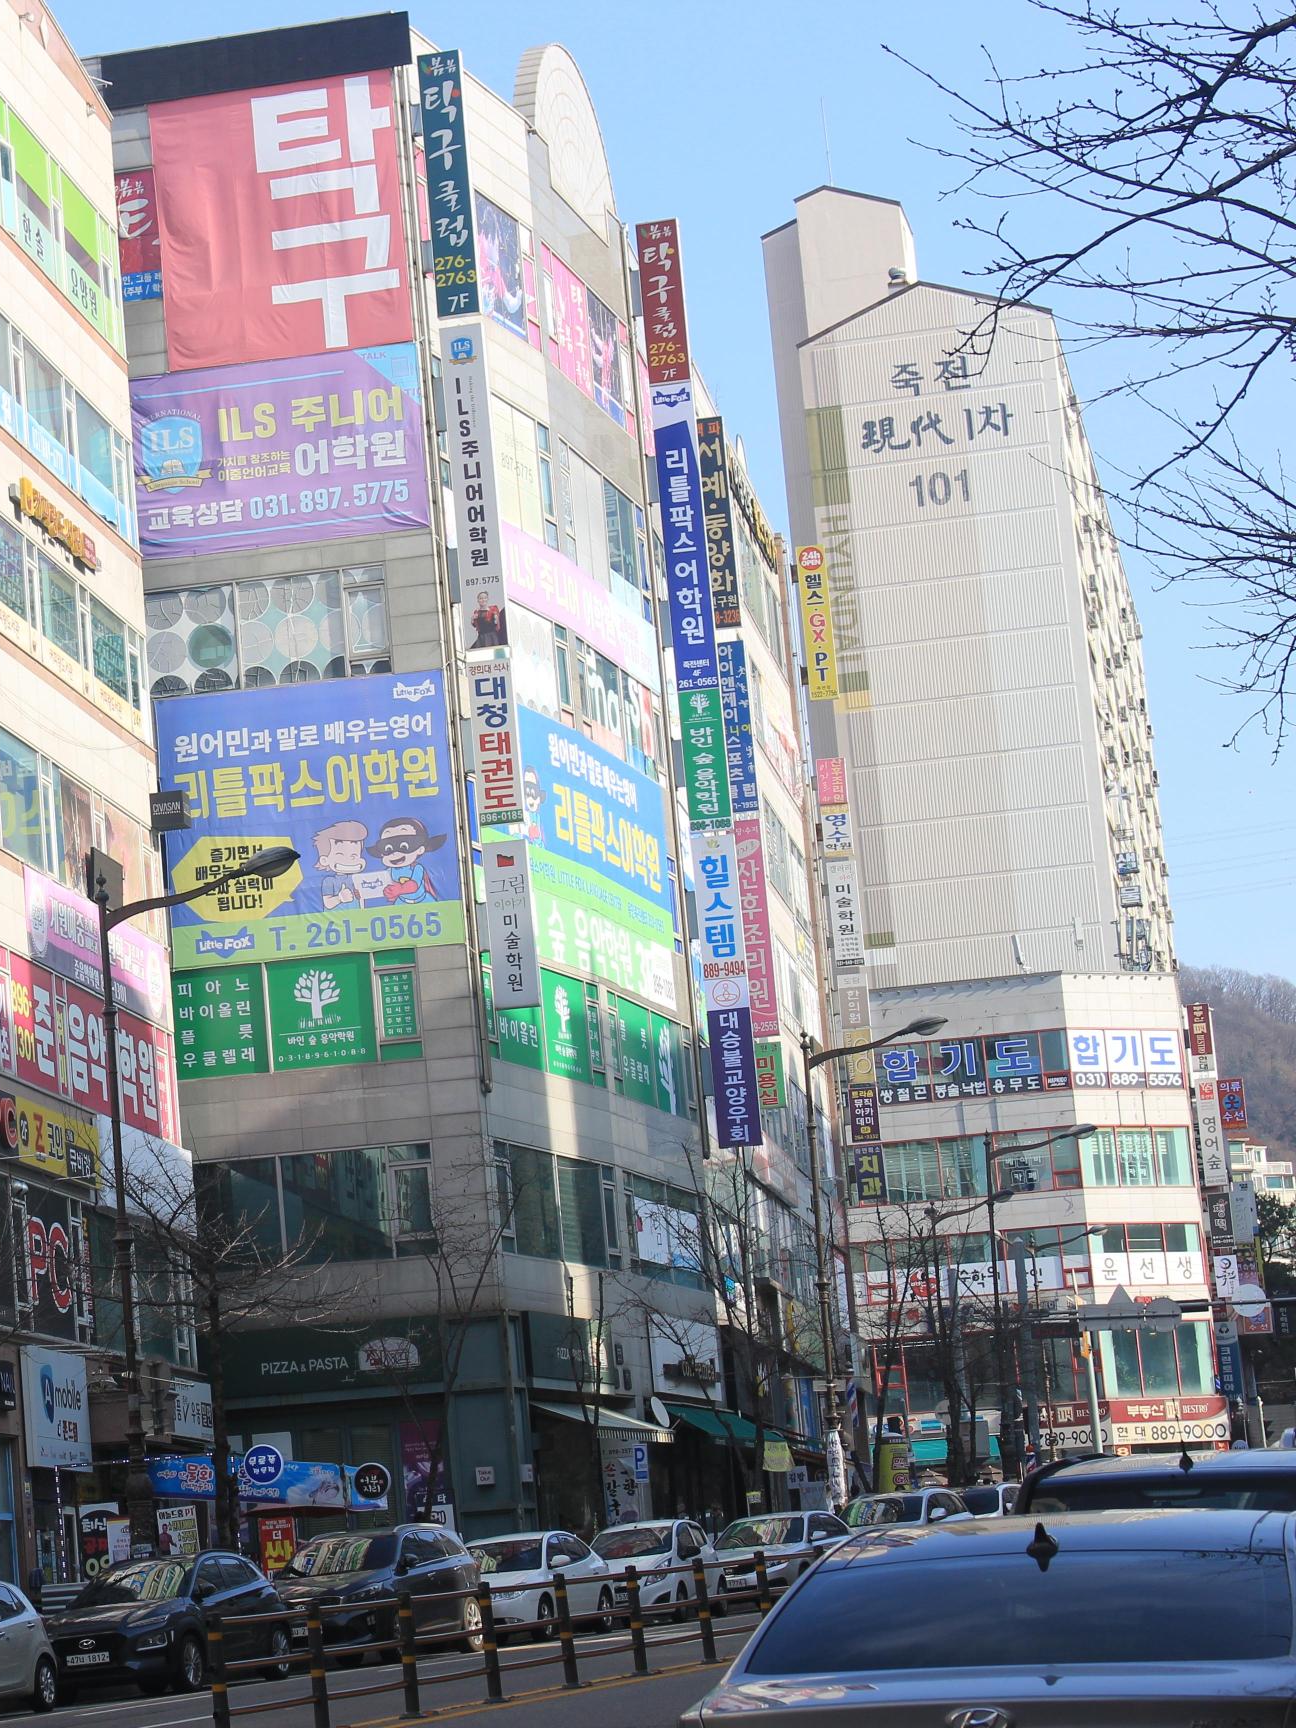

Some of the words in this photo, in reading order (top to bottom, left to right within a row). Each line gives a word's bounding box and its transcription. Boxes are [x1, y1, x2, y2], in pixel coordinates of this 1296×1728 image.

[251, 76, 400, 349] 탁구
[434, 255, 472, 271] 276-
[70, 267, 99, 320] 요양원
[436, 270, 477, 288] 2763
[448, 293, 469, 313] 7F
[648, 342, 681, 354] 276-
[650, 353, 686, 367] 2763
[661, 368, 677, 381] 7F
[891, 355, 972, 396] 죽전
[217, 402, 276, 442] ILS
[291, 386, 404, 433] 주니어
[150, 427, 194, 453] ILS
[294, 430, 407, 476] 어학원
[217, 462, 292, 482] 이중언어교육
[909, 469, 971, 508] 101
[148, 500, 242, 531] 교육상담
[249, 478, 409, 520] 031.897.5775
[665, 447, 705, 646] 리틀팍스어학원
[801, 559, 822, 567] OPEN
[465, 575, 500, 587] 897.5775
[820, 514, 863, 671] HYUNDAI
[678, 676, 718, 688] 261-0565
[474, 676, 508, 728] 대청
[174, 728, 272, 763] 원어민과
[276, 724, 320, 747] 말로
[174, 746, 440, 820] 리틀팍스어학원
[478, 731, 517, 811] 태권도
[152, 801, 181, 813] CIVASAN
[480, 810, 523, 824] 896-0185
[553, 783, 662, 894] 리틀팍스어학원
[234, 876, 274, 893] 실력이
[490, 877, 526, 904] 그림
[217, 894, 264, 910] 됩니다!
[699, 854, 735, 958] 힐스템
[835, 883, 855, 935] 미술학원
[270, 926, 296, 951] T.
[307, 912, 442, 939] 261-0565
[503, 913, 524, 992] 미술학원
[704, 961, 746, 978] 889-9494
[179, 1000, 252, 1021] 바이올린
[499, 1015, 539, 1048] 바이올린
[182, 1047, 256, 1068] 우쿨렐레
[882, 1038, 1032, 1084] 합기도
[1073, 1034, 1177, 1066] 합기도
[719, 1010, 750, 1142] 대승불교양우회
[756, 1054, 779, 1106] 미용실
[880, 1086, 927, 1104] 쌍절곤
[992, 1075, 1041, 1094] 용무도
[1075, 1072, 1107, 1087] 031)
[1111, 1072, 1146, 1086] 889-
[1148, 1072, 1182, 1087] 5576
[1219, 1081, 1242, 1092] 의류
[1223, 1110, 1245, 1122] 수선
[1202, 1116, 1223, 1170] 영어숲
[859, 1154, 882, 1196] 치과
[27, 1216, 72, 1313] PC
[1102, 1255, 1193, 1280] 윤선생
[261, 1361, 299, 1375] PIZZA
[309, 1356, 350, 1372] PASTA
[54, 1377, 82, 1410] mobile
[1126, 1404, 1164, 1419] 부동산
[1117, 1425, 1146, 1438] 현대
[1151, 1422, 1227, 1441] 889-9000
[635, 1446, 645, 1465] P
